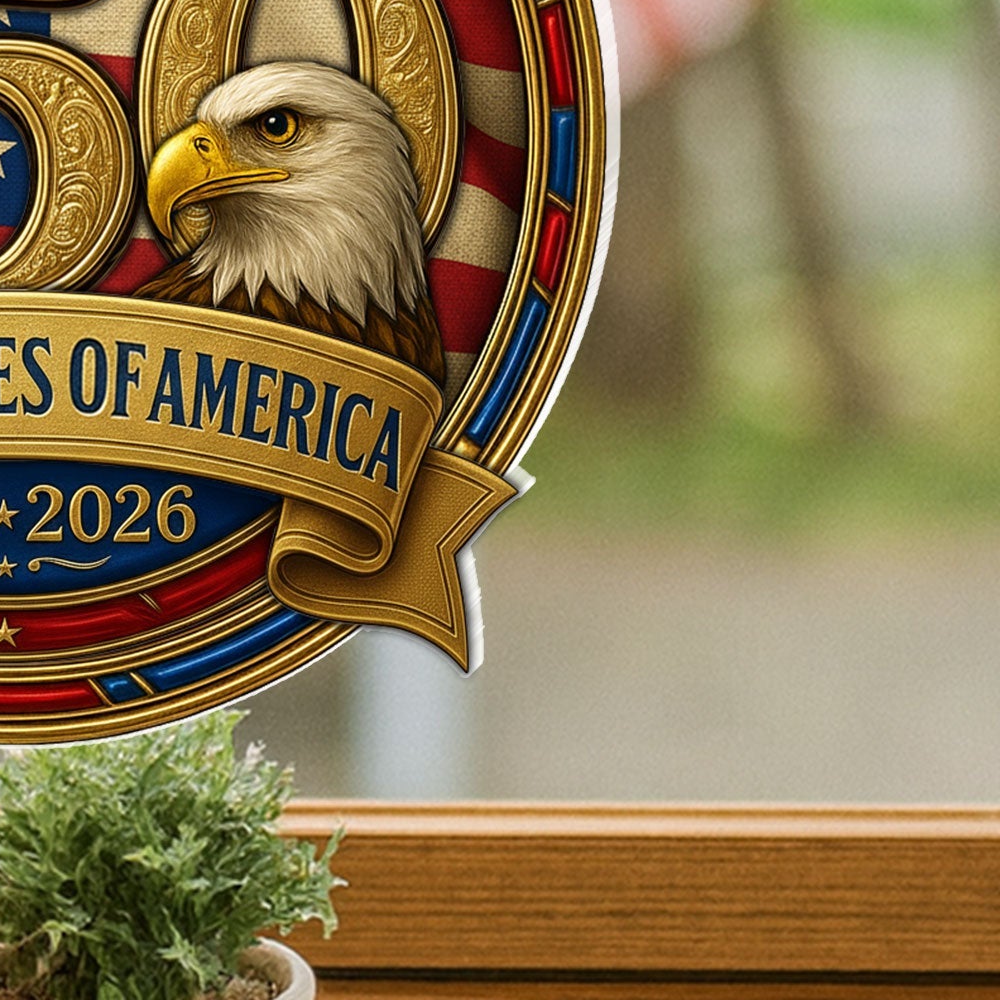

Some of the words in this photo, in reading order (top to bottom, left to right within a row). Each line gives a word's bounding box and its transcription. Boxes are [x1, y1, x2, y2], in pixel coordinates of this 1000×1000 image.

[68, 337, 149, 418] OF
[150, 348, 402, 493] AMERICA
[26, 482, 197, 545] 2026
